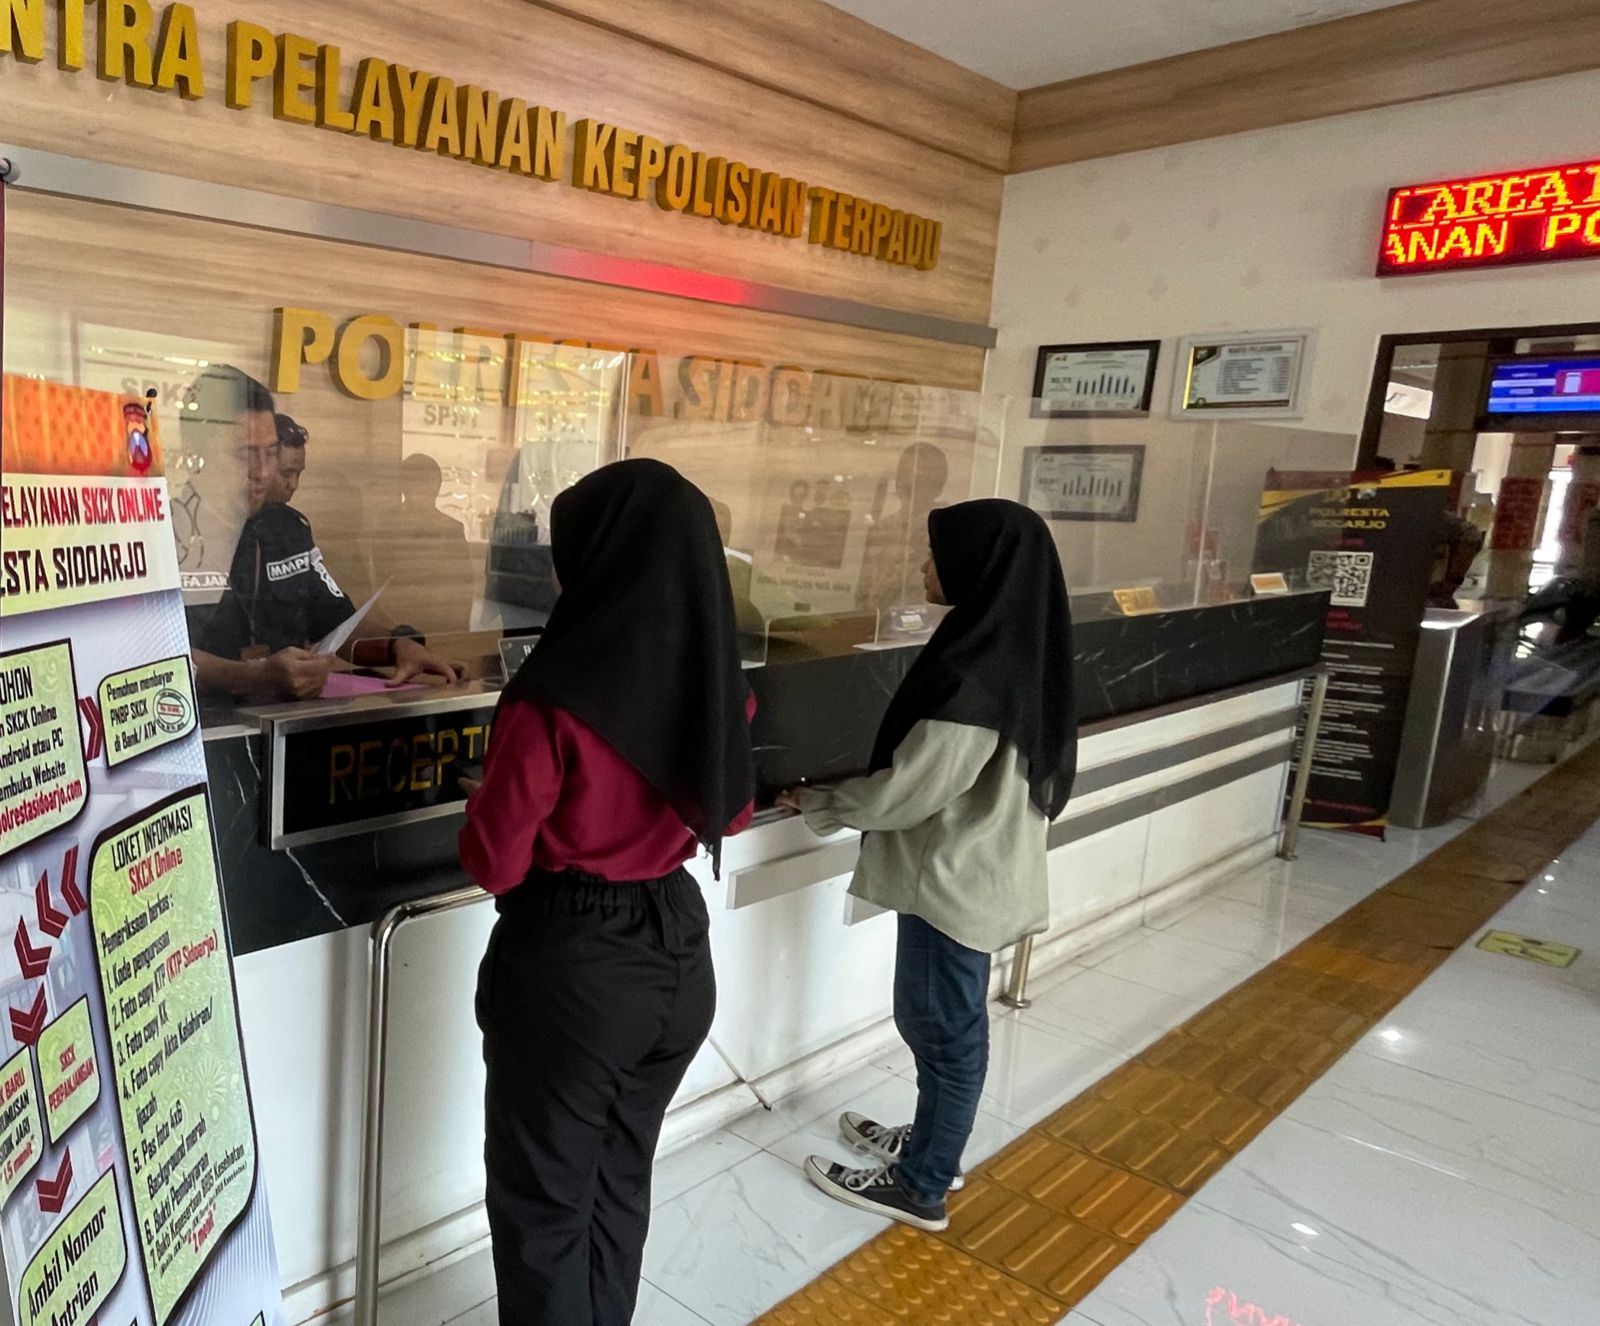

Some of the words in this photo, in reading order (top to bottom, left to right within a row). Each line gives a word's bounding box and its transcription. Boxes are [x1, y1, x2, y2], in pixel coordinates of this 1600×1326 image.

[226, 20, 566, 182] PELAYANAN
[572, 119, 808, 238] KEPOLISIAN
[808, 186, 943, 271] TERPADU
[1420, 171, 1573, 222] AREA
[81, 487, 116, 524] SKCK
[117, 487, 165, 524] ONLINE
[53, 541, 147, 589] SIDOARJO
[6, 708, 30, 736] SKCK
[30, 704, 57, 727] Online
[131, 698, 149, 721] SKCK
[32, 737, 51, 756] atau
[51, 727, 64, 750] PC
[33, 760, 67, 787] Website
[0, 778, 83, 835] olrestasidoarjo.com
[111, 831, 142, 872] LOKET
[143, 805, 193, 852] INFORMASI
[128, 854, 155, 895] SKCK
[155, 846, 183, 878] Online
[113, 956, 131, 988] Kode
[119, 995, 137, 1023] Foto
[138, 981, 154, 1009] copy
[154, 962, 166, 993] KTP
[125, 1030, 143, 1059] Foto
[143, 1016, 159, 1044] copy
[130, 1066, 148, 1095] Foto
[148, 1049, 164, 1078] copy
[141, 1138, 156, 1165] Pas
[27, 1250, 63, 1326] Ambil
[63, 1205, 106, 1272] Nomor
[52, 1270, 98, 1326] Antrian
